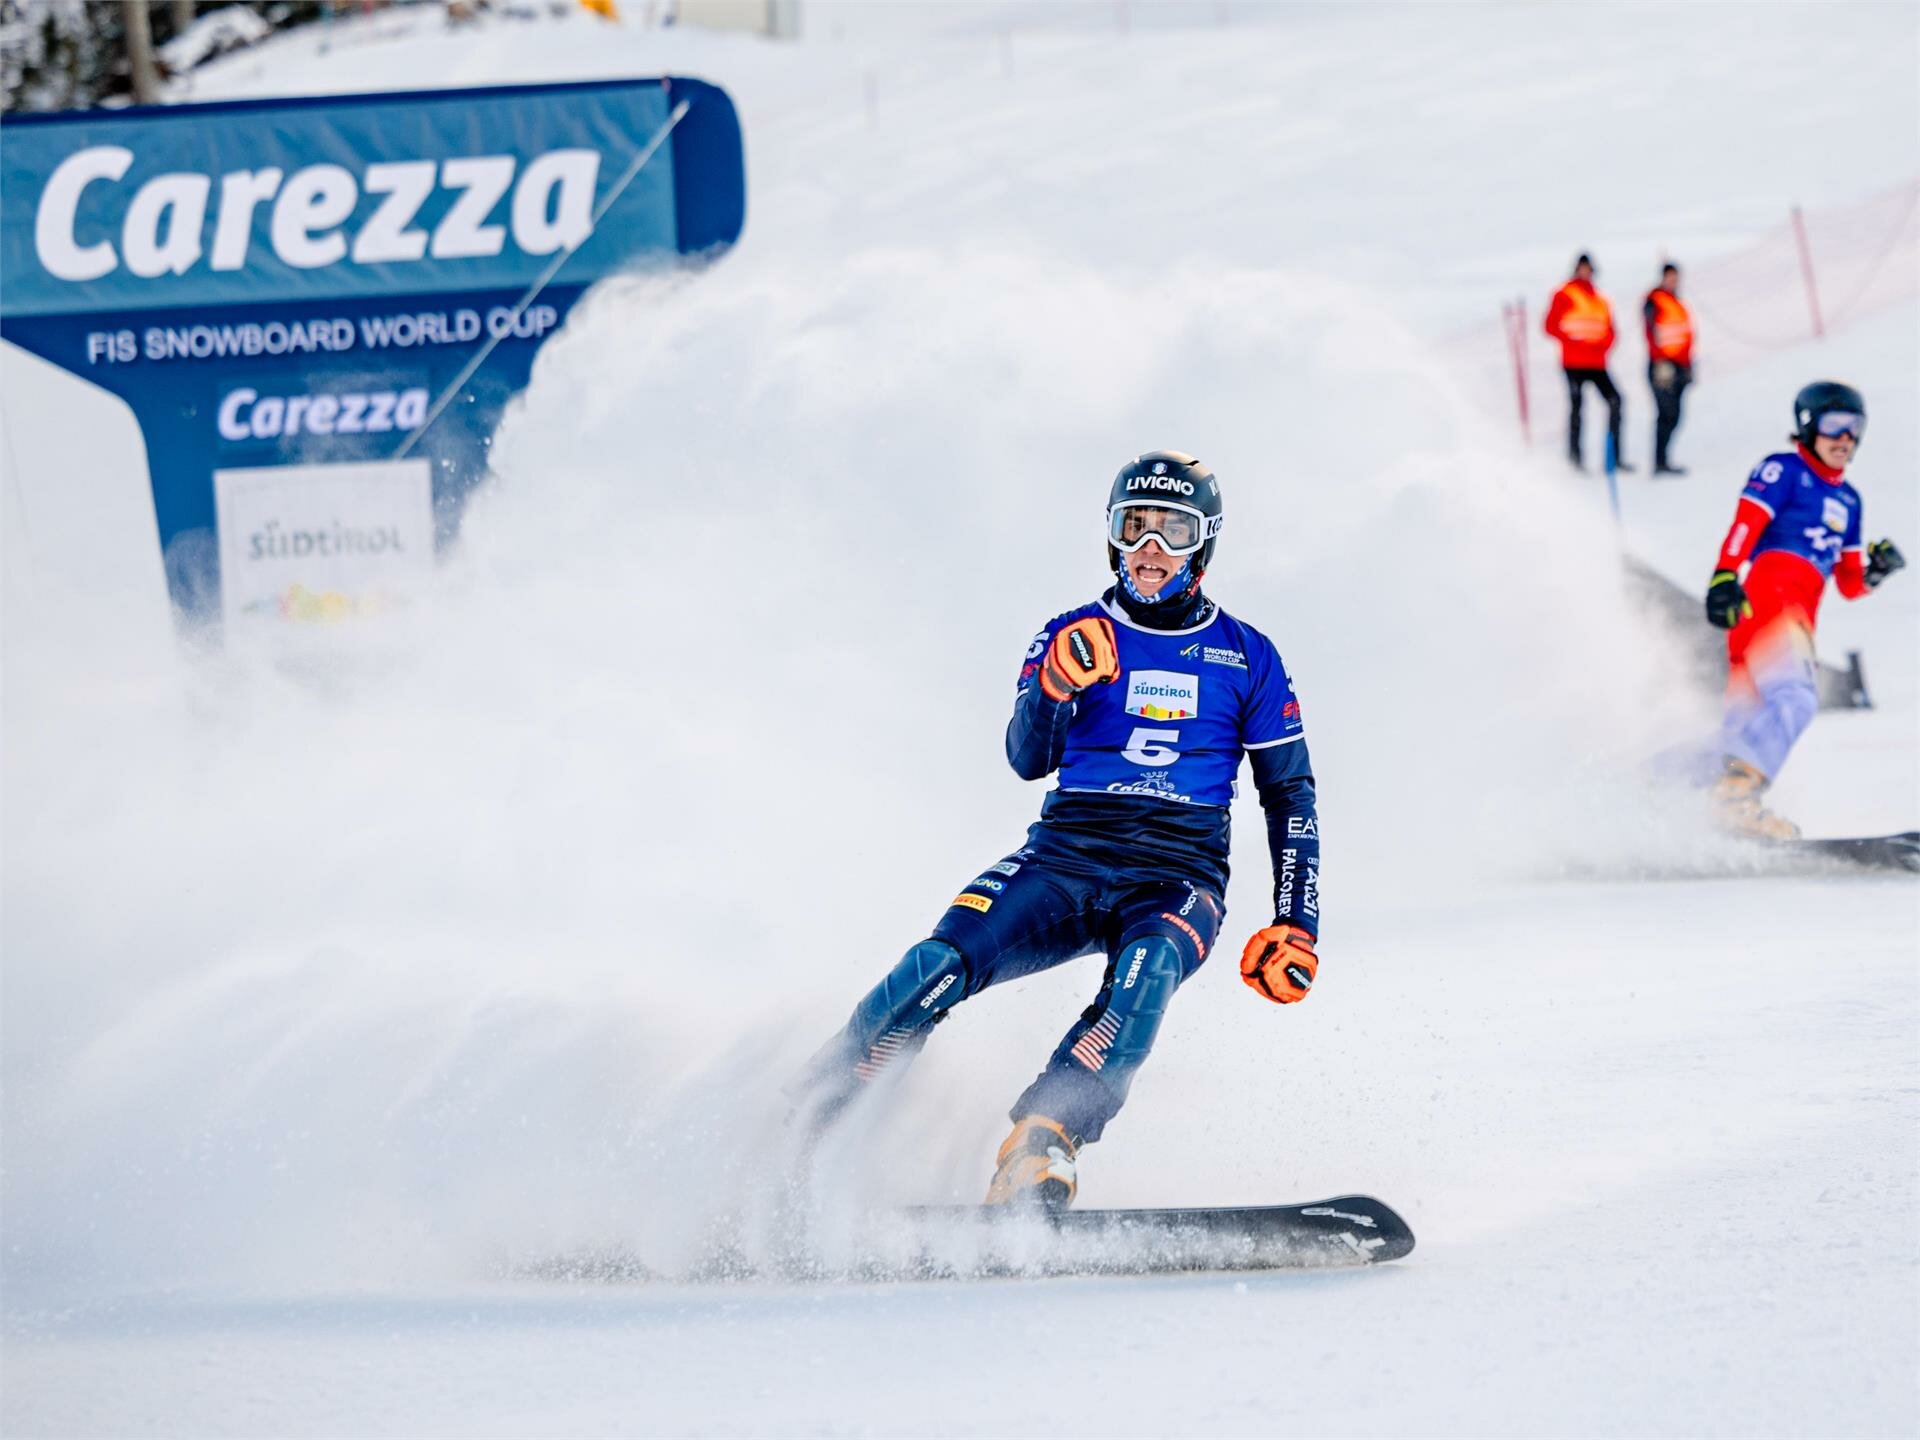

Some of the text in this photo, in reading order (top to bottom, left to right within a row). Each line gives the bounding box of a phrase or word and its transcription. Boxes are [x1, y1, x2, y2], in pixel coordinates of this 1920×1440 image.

[34, 146, 601, 281] Carezza
[87, 306, 558, 364] FIS SNOWBOARD WORLD CUP
[217, 387, 431, 441] Carezza
[1126, 475, 1195, 496] LIVIGNO
[1120, 727, 1180, 767] 5
